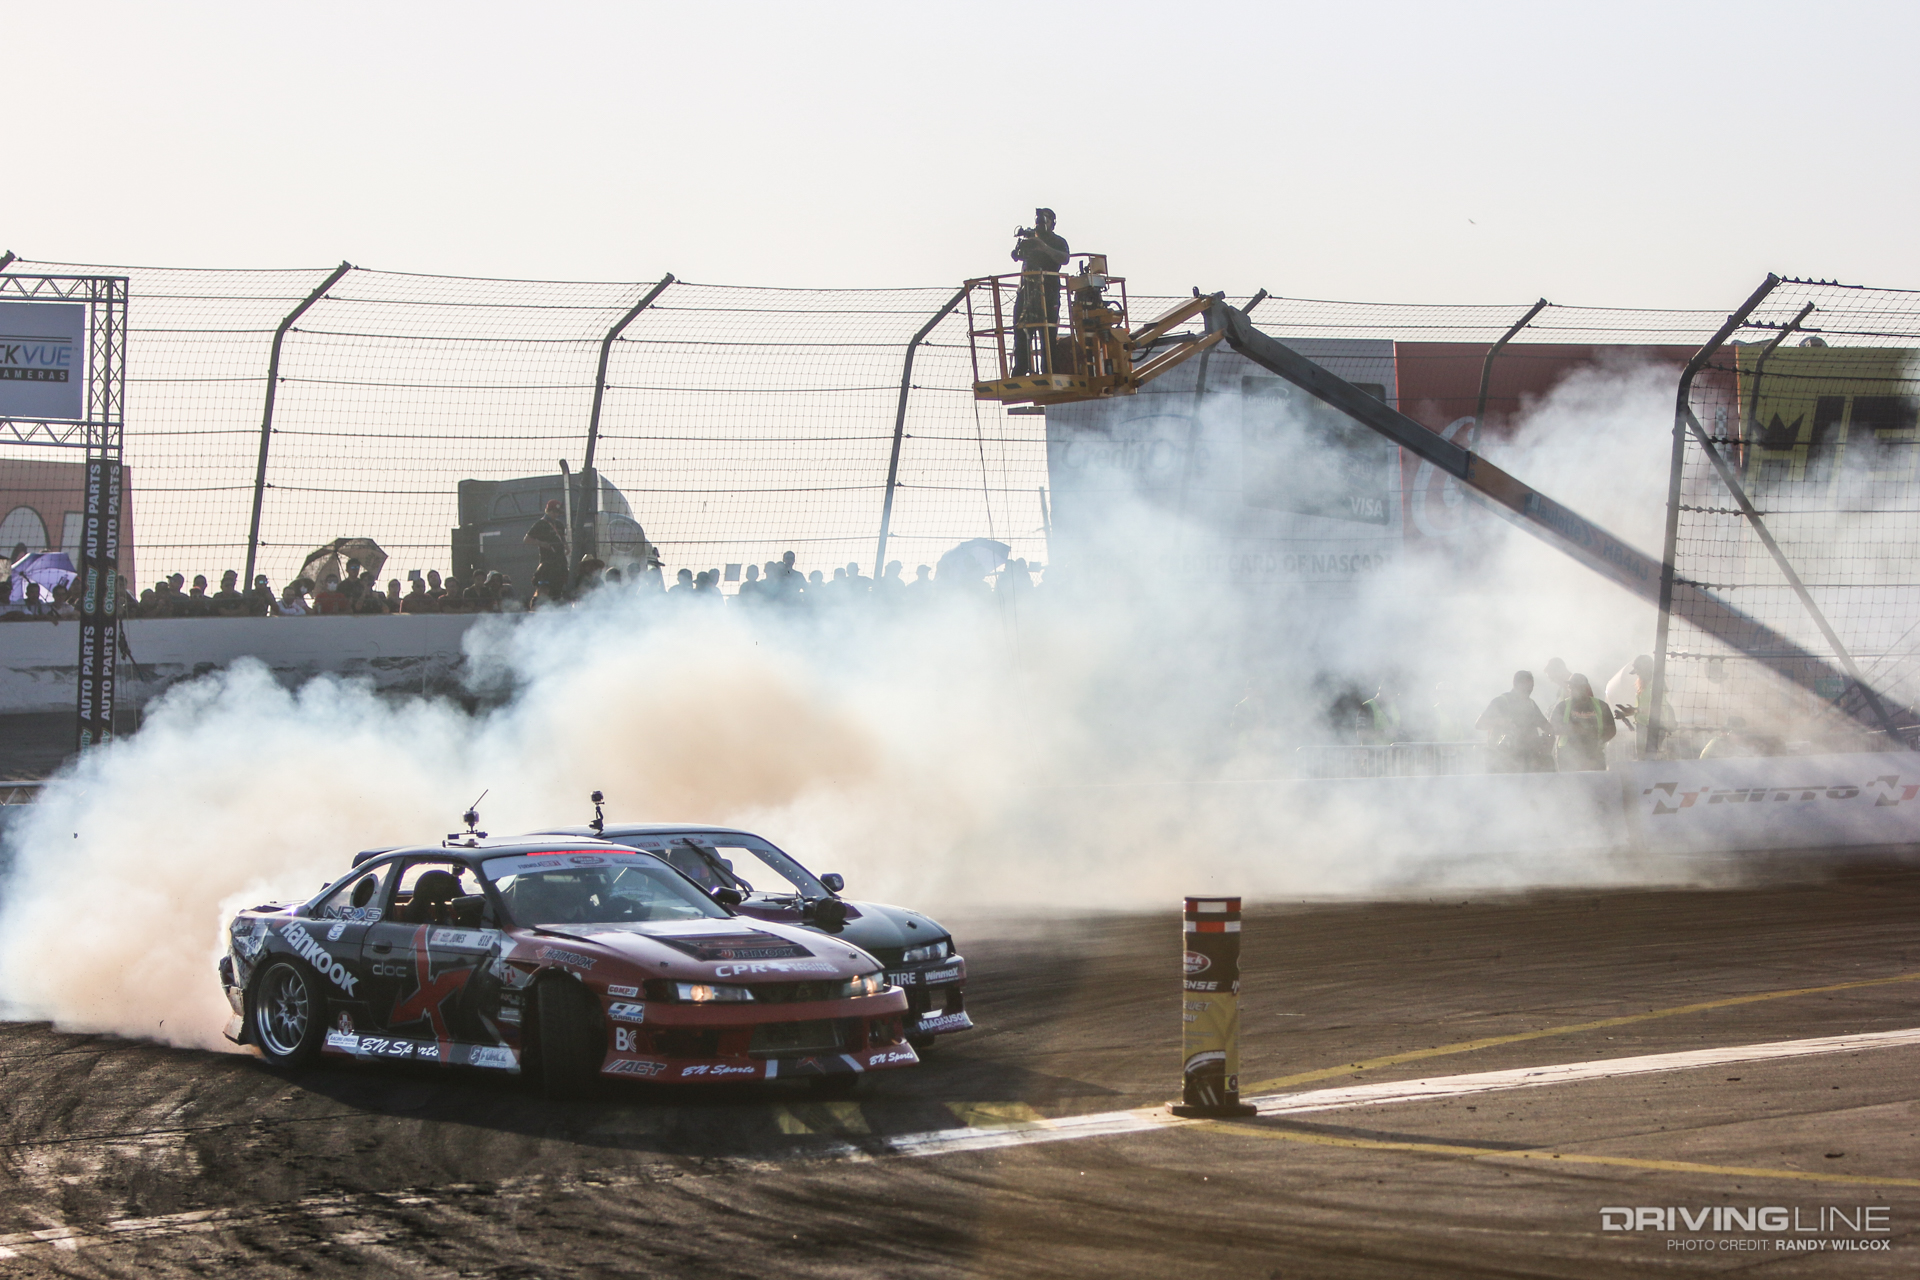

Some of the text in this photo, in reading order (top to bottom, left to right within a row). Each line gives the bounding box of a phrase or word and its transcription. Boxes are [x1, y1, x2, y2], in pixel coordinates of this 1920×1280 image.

[88, 463, 101, 514] PARTS
[108, 465, 120, 515] PARTS
[1350, 496, 1384, 517] VISA
[86, 517, 99, 559] AUTO
[106, 518, 118, 560] AUTO
[1227, 553, 1278, 574] CARD
[1282, 553, 1308, 574] OF
[82, 625, 95, 676] PARTS
[103, 626, 114, 677] PARTS
[81, 679, 93, 720] AUTO
[101, 680, 112, 721] AUTO
[1707, 785, 1860, 804] NITTO
[715, 963, 768, 977] CPR
[888, 972, 917, 986] TIRE
[388, 1041, 439, 1056] Sprts
[888, 1052, 914, 1063] Sports
[710, 1064, 755, 1076] Sports
